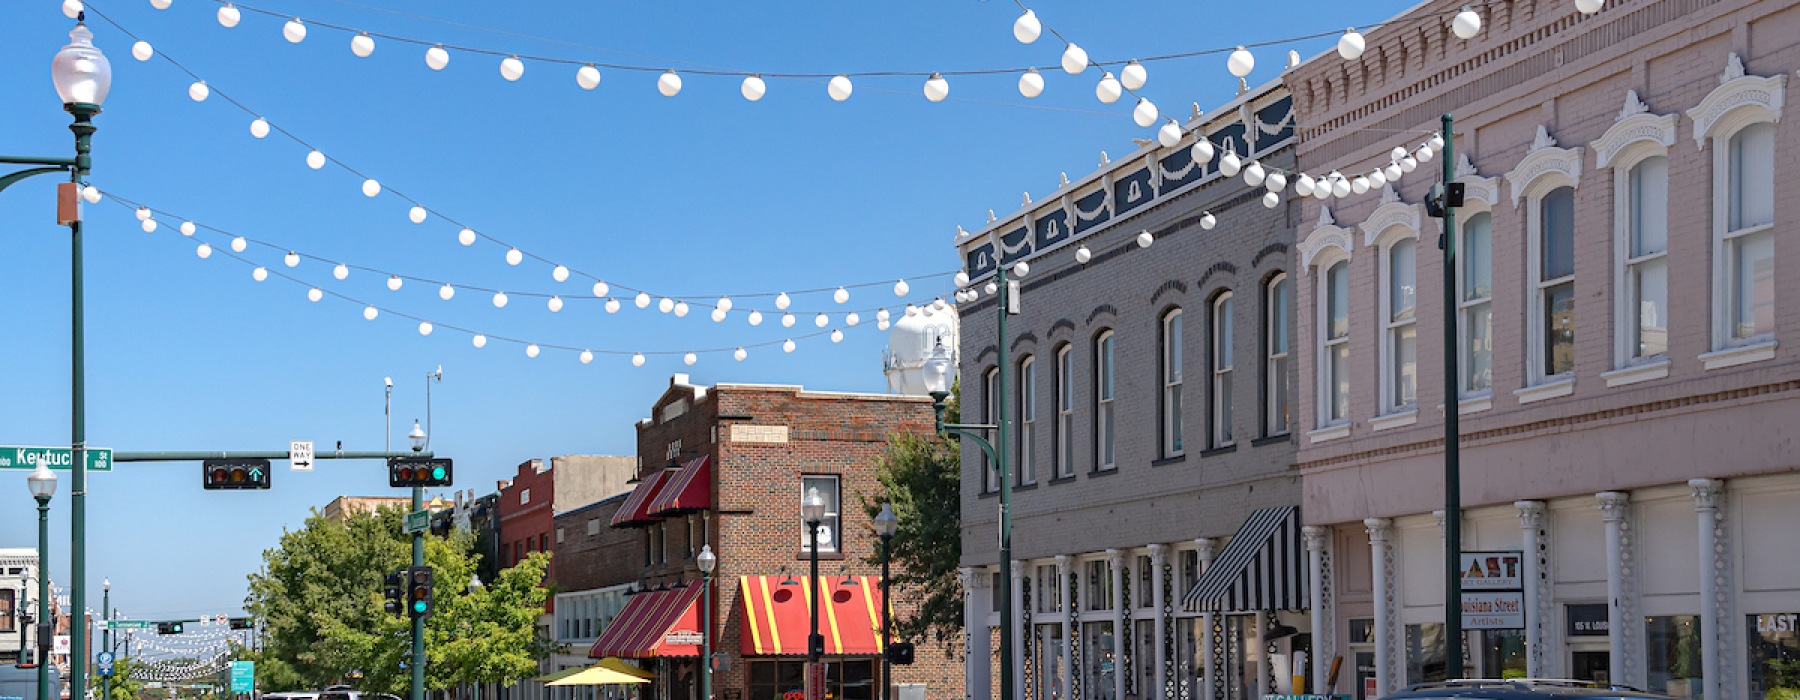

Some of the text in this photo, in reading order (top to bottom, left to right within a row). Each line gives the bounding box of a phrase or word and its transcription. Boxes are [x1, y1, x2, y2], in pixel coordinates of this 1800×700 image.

[17, 448, 89, 466] Ketuc
[1460, 556, 1519, 578] AST
[1460, 597, 1519, 613] ouisiana Street
[1470, 617, 1504, 625] Artists
[1757, 614, 1798, 632] LAST
